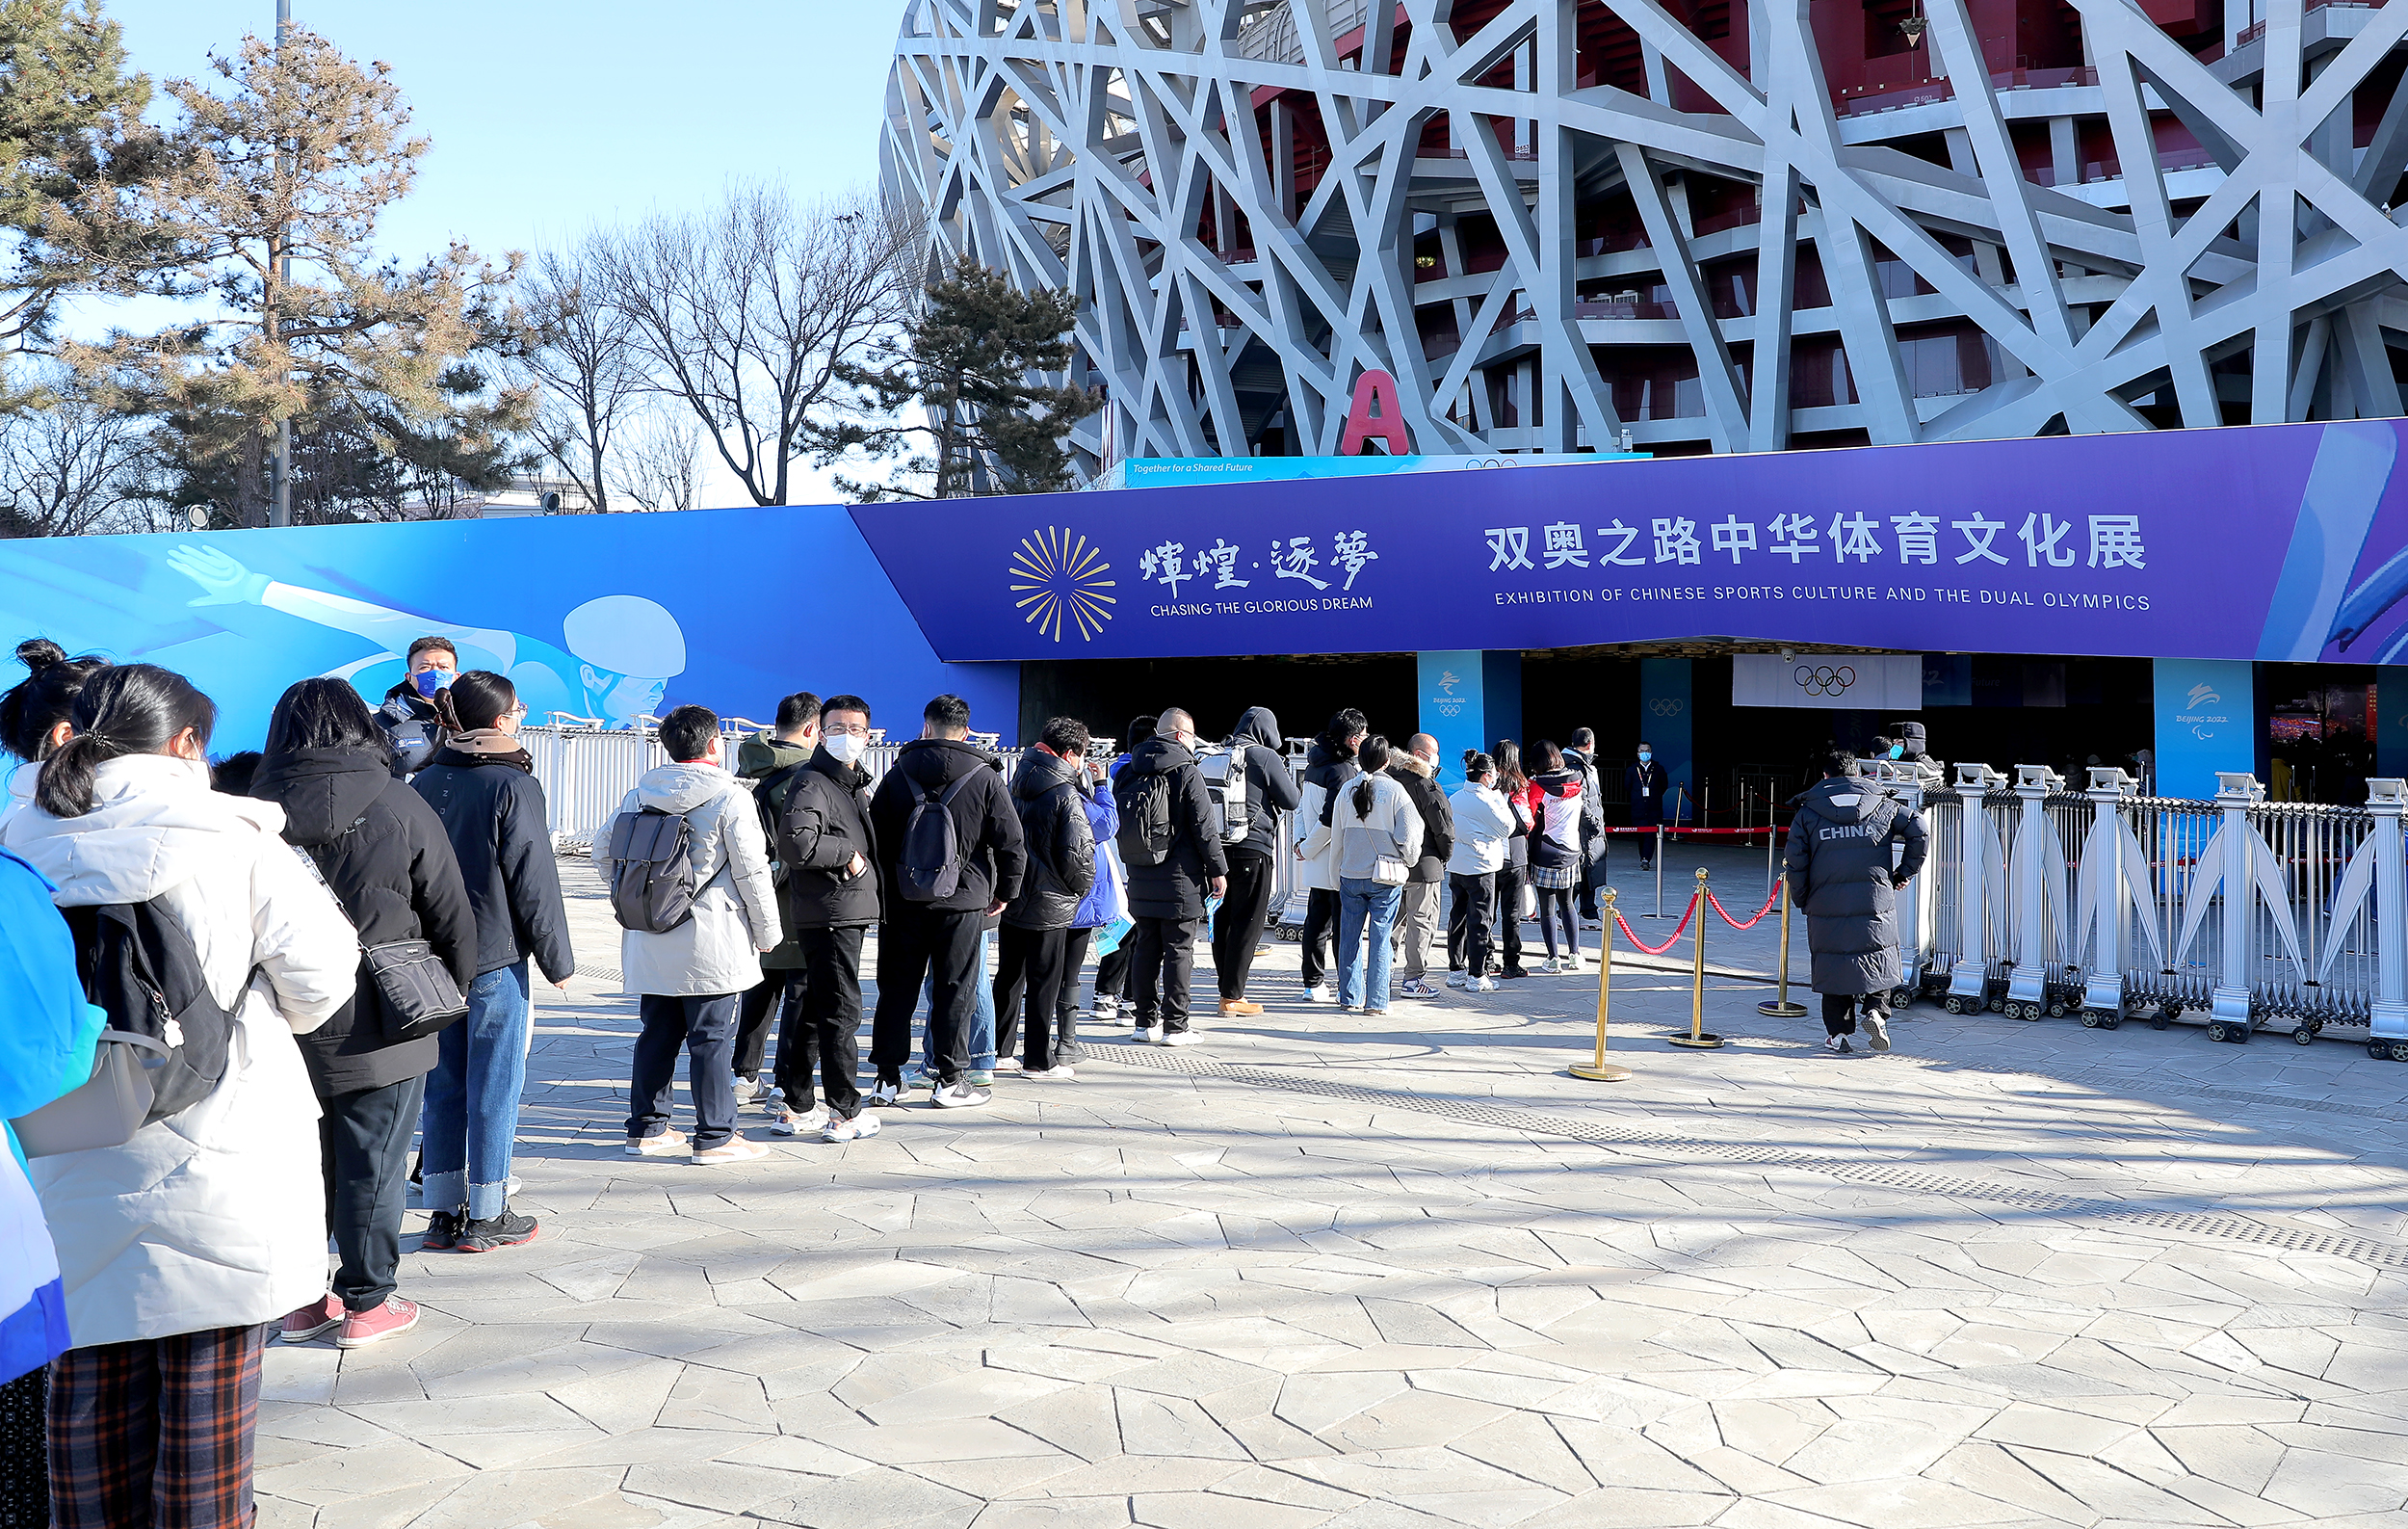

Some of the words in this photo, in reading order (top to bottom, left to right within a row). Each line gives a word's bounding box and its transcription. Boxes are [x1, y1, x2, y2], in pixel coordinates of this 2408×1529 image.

[1341, 369, 1409, 456] A
[1134, 464, 1171, 474] Together
[1193, 463, 1223, 472] Shared
[1225, 462, 1253, 472] Future
[1484, 511, 2147, 571] 双奥之路中华体育文化展
[1150, 602, 1213, 617] CHASING
[1216, 601, 1241, 615] THE
[1243, 598, 1318, 614] GLORIOUS
[1322, 596, 1374, 611] DREAM
[1495, 589, 1594, 605] EXHIBITION
[1601, 588, 1623, 601] OF
[1630, 587, 1706, 601] CHINESE
[1714, 586, 1784, 600] SPORTS
[1792, 586, 1877, 600] CULTURE
[1886, 587, 1926, 601] AND
[1934, 588, 1972, 603] THE
[1979, 590, 2034, 606] DUAL
[2043, 592, 2150, 611] OLYMPICS
[2176, 715, 2205, 725] BEIJING
[1819, 825, 1876, 841] CHINA
